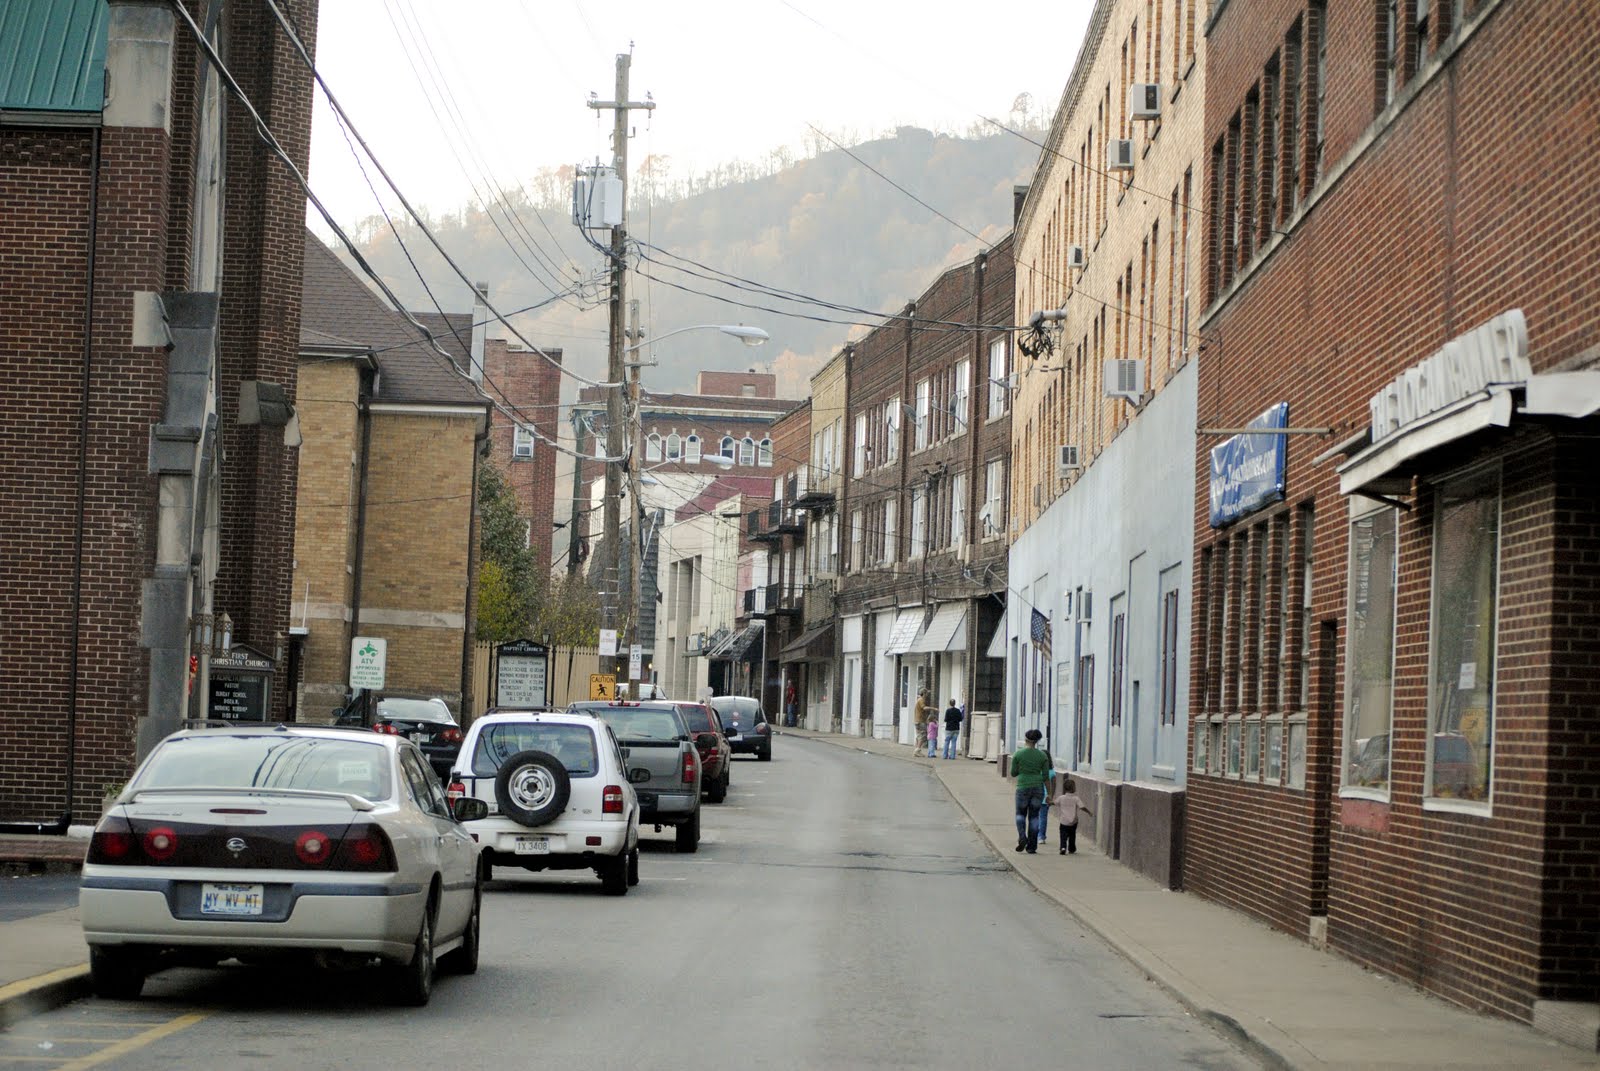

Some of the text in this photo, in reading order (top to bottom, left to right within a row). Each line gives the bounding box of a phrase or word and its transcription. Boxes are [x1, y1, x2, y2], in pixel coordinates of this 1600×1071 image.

[592, 675, 614, 683] CAUTION
[206, 893, 259, 908] MY WV MT
